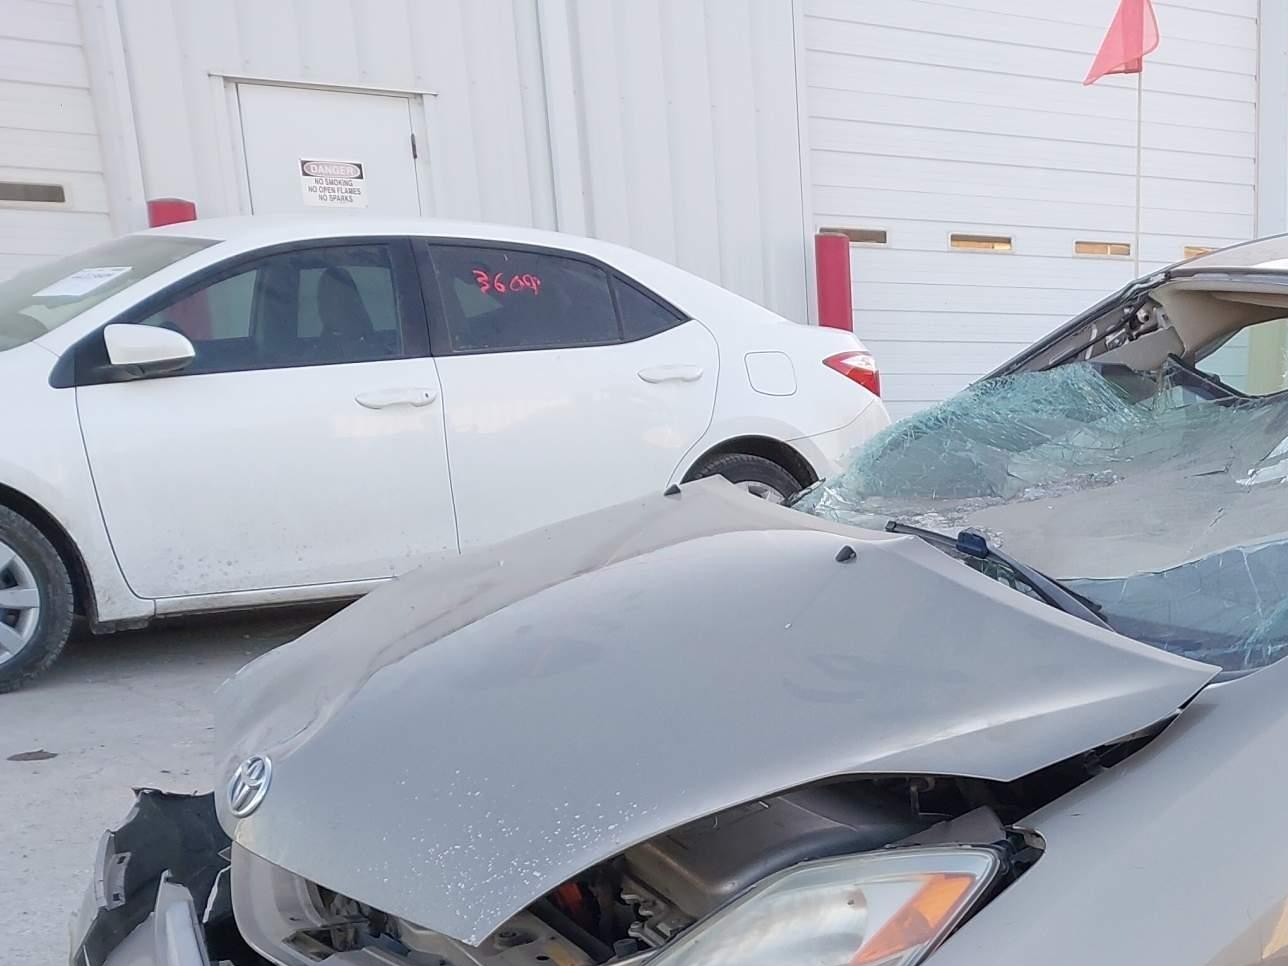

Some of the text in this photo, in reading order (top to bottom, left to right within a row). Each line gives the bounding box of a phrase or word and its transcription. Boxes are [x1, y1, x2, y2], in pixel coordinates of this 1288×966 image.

[310, 164, 354, 176] DANGER
[325, 179, 353, 187] SMOKING
[319, 186, 335, 194] OPEN
[337, 187, 361, 195] FLAMES
[329, 195, 353, 203] SPARKS
